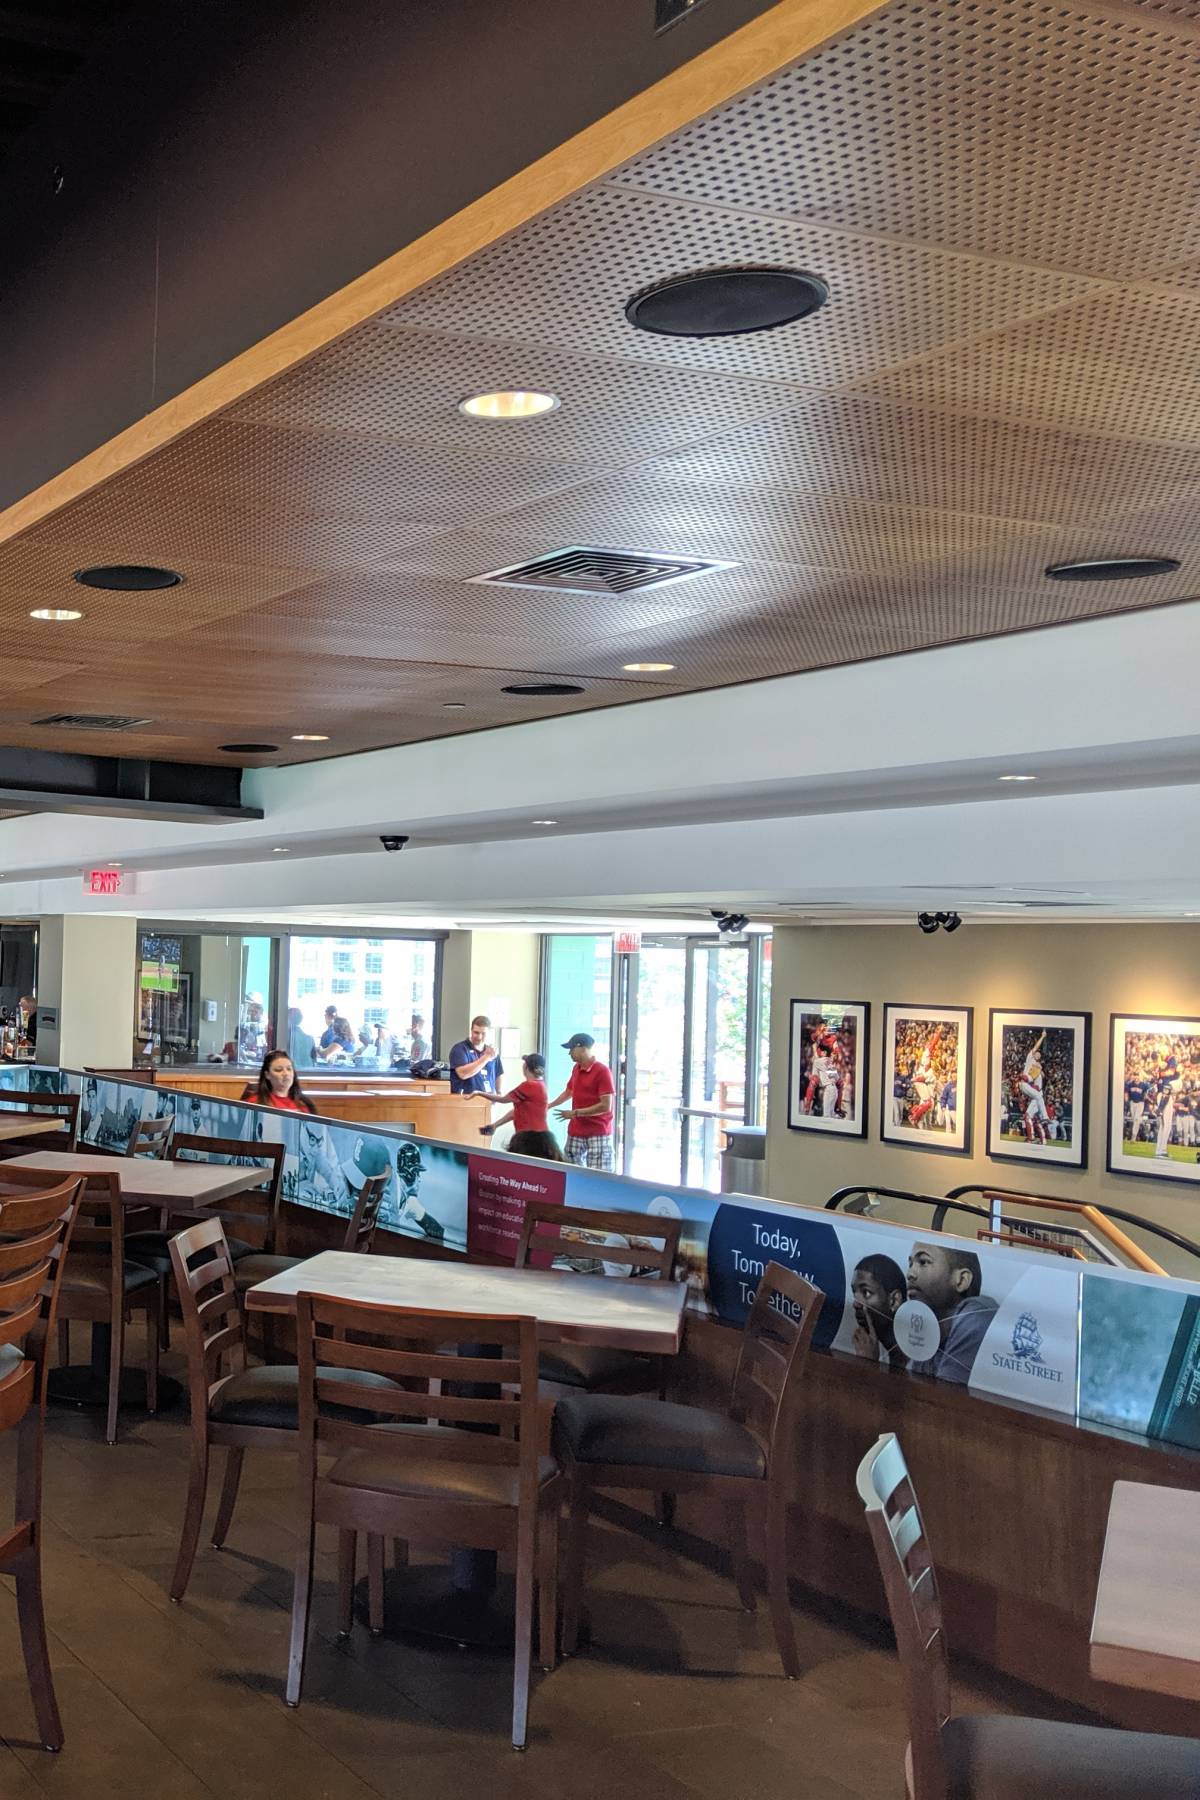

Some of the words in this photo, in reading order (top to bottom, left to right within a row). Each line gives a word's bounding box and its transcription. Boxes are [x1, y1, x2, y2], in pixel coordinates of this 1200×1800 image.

[90, 870, 119, 893] EXIT
[499, 1176, 510, 1186] The
[510, 1178, 522, 1190] Way
[521, 1181, 539, 1192] Ahead
[751, 1223, 801, 1259] Today,
[991, 1352, 1024, 1372] STATE
